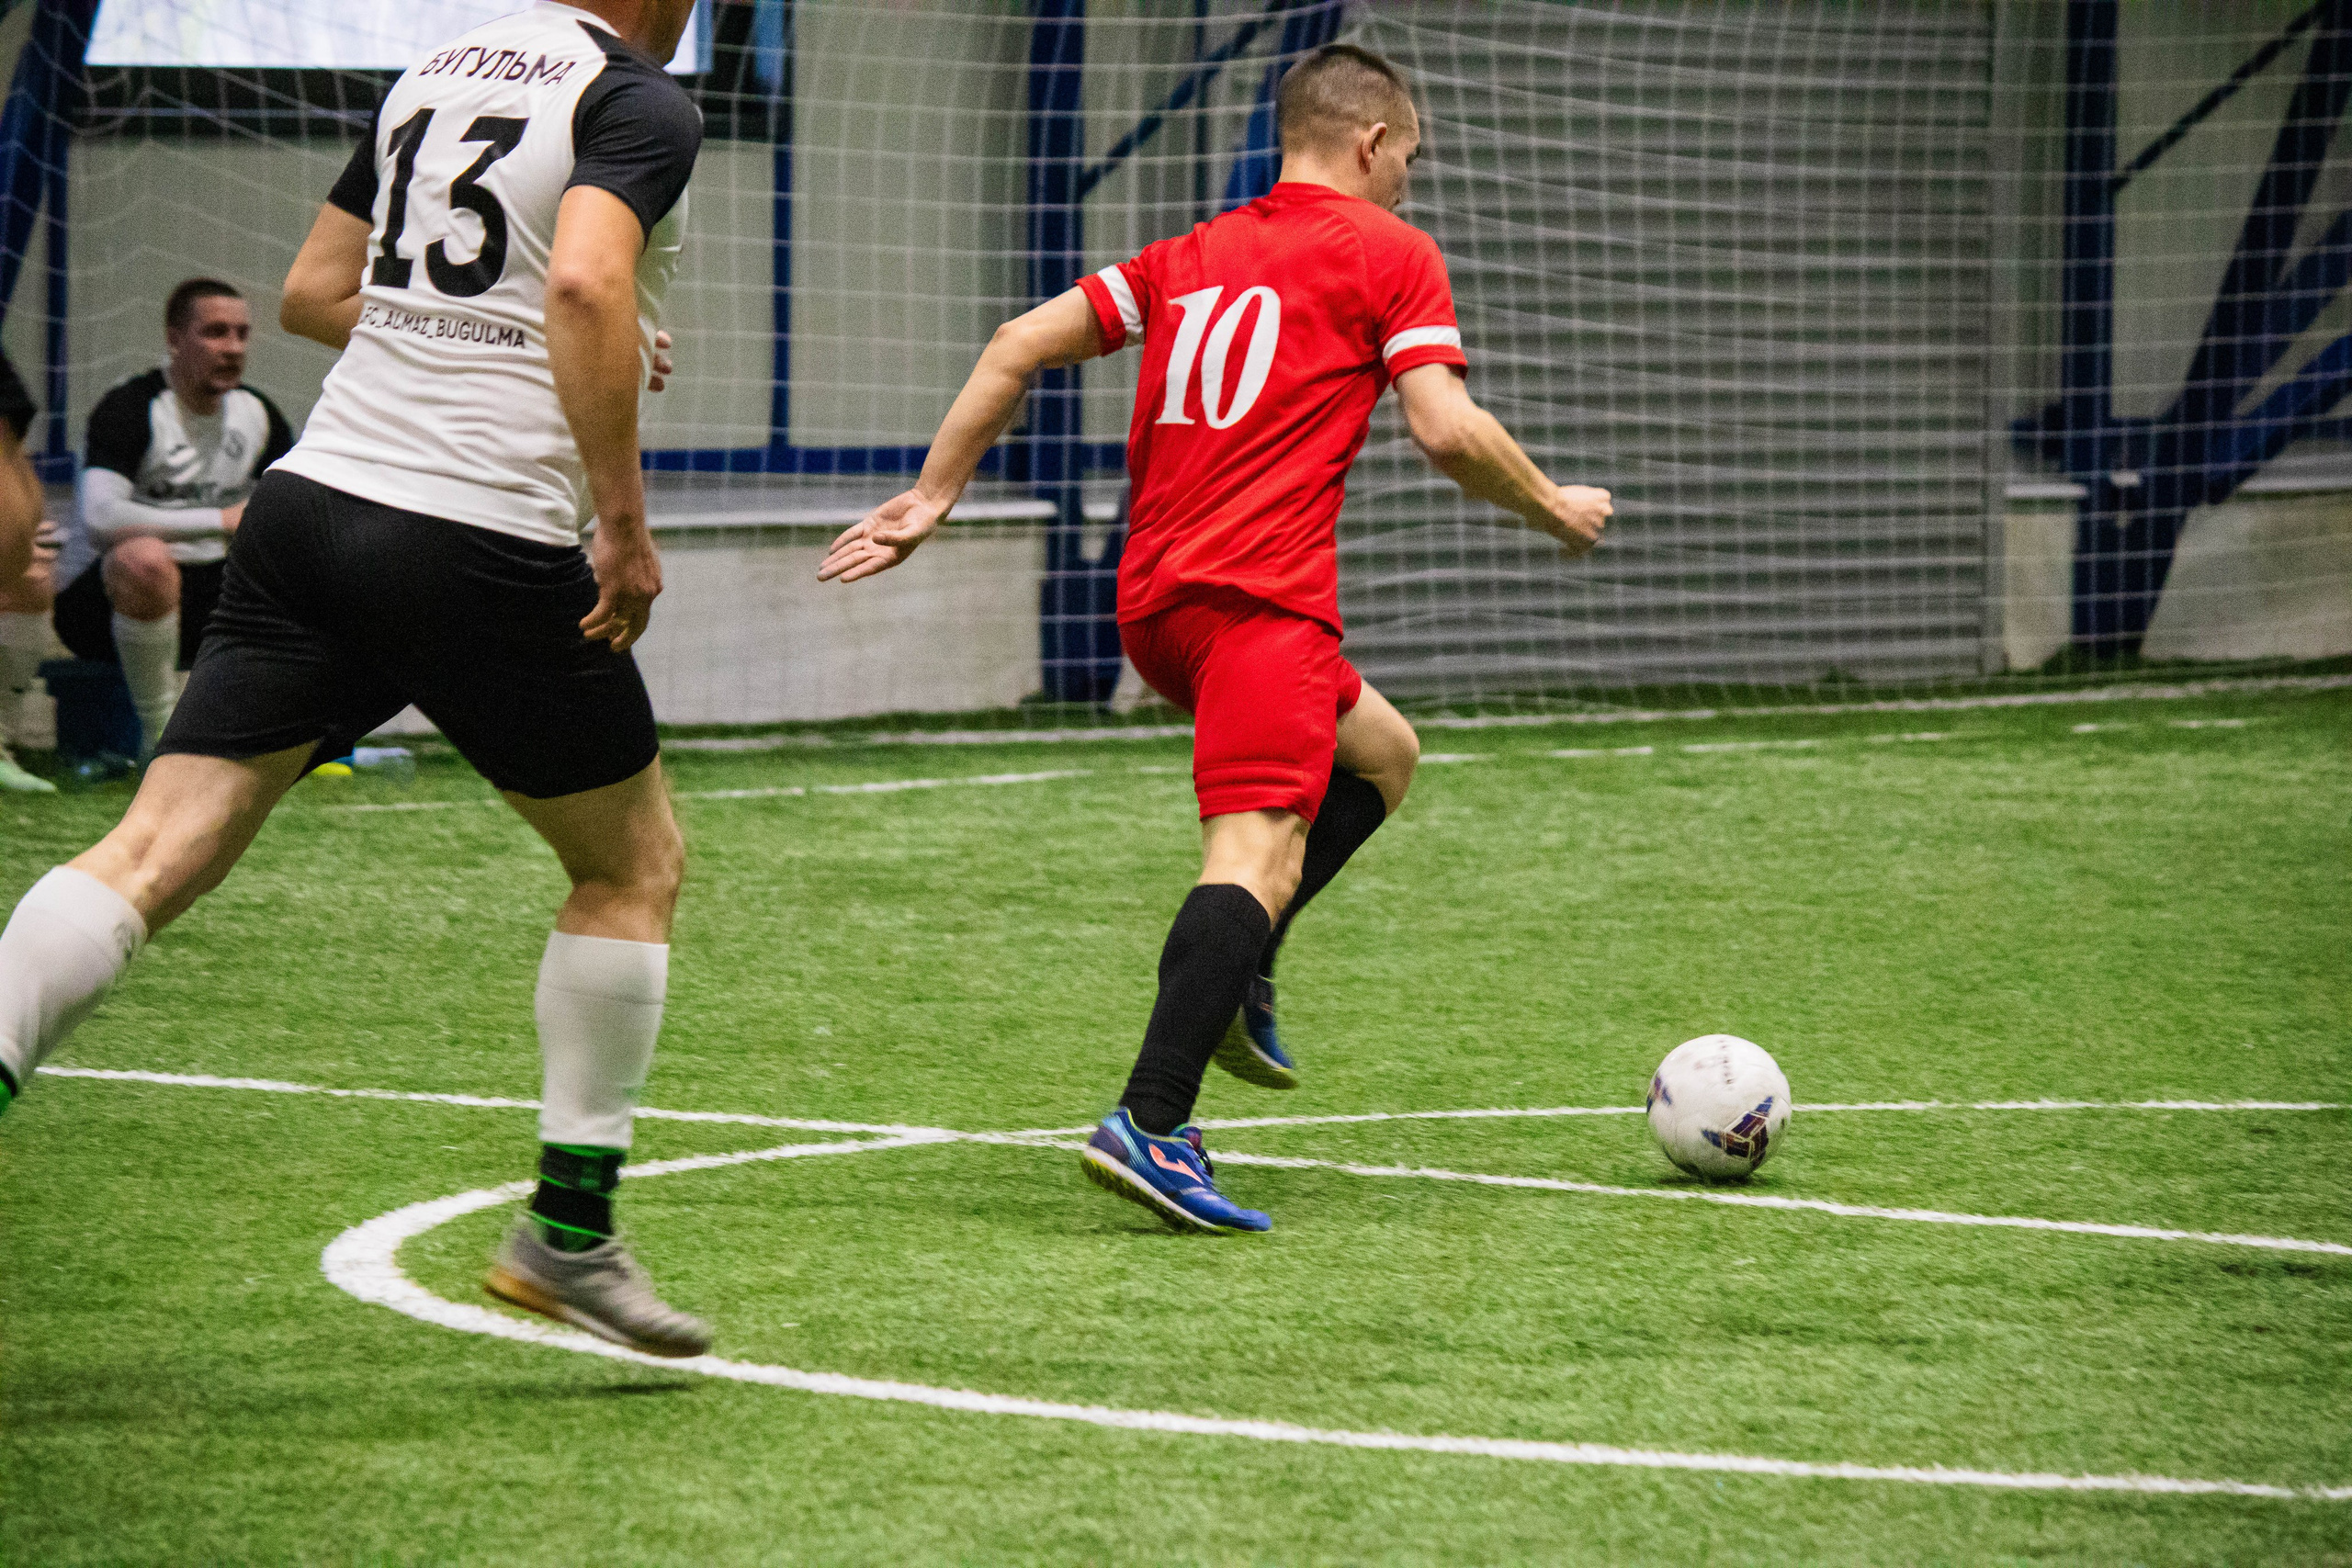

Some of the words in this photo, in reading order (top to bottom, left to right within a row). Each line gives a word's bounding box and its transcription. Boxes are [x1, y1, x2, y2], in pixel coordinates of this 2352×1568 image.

[418, 46, 577, 85] БУГУЛЬМА
[372, 107, 530, 298] 13
[1155, 286, 1281, 430] 10
